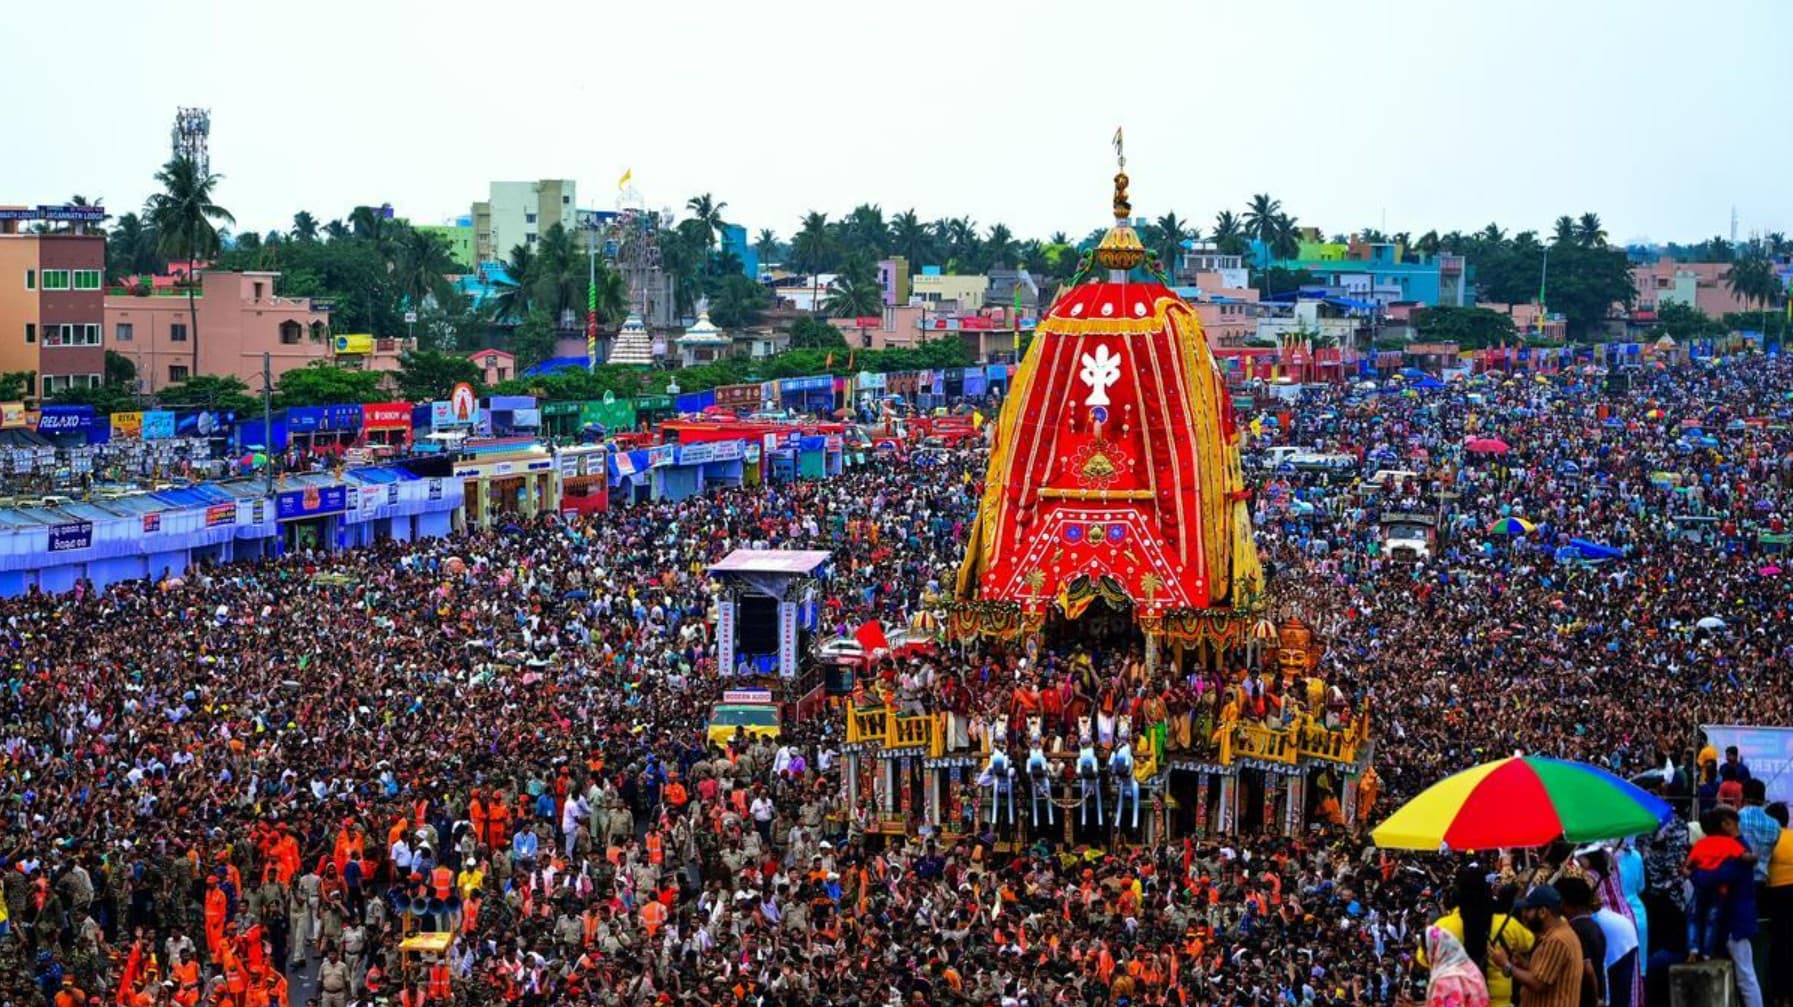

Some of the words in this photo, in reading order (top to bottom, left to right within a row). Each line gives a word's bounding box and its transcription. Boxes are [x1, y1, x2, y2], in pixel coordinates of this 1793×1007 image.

[46, 211, 82, 219] JAGANNATH
[84, 212, 103, 220] LODGE
[40, 415, 79, 428] RELAXO
